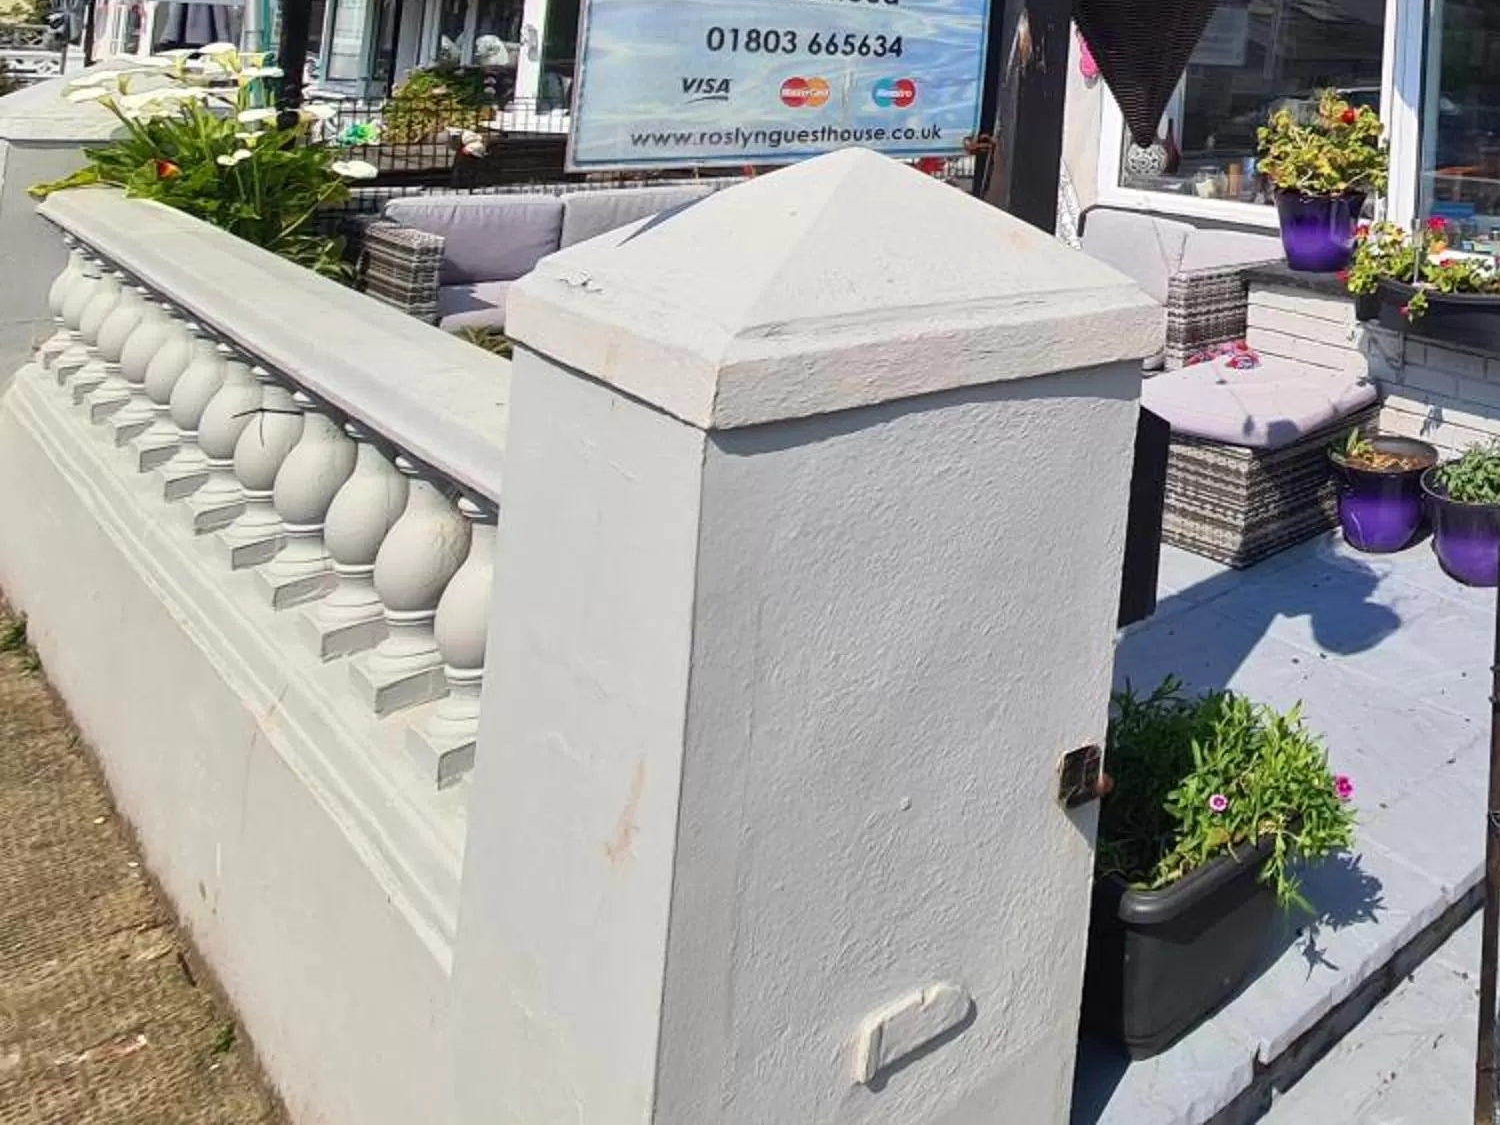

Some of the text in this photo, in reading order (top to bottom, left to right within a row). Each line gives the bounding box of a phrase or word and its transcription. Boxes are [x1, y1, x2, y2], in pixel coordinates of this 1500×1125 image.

[706, 27, 904, 58] 01803 665634
[682, 78, 731, 94] VISA
[630, 123, 942, 148] www.roslynguesthouse.co.uk
